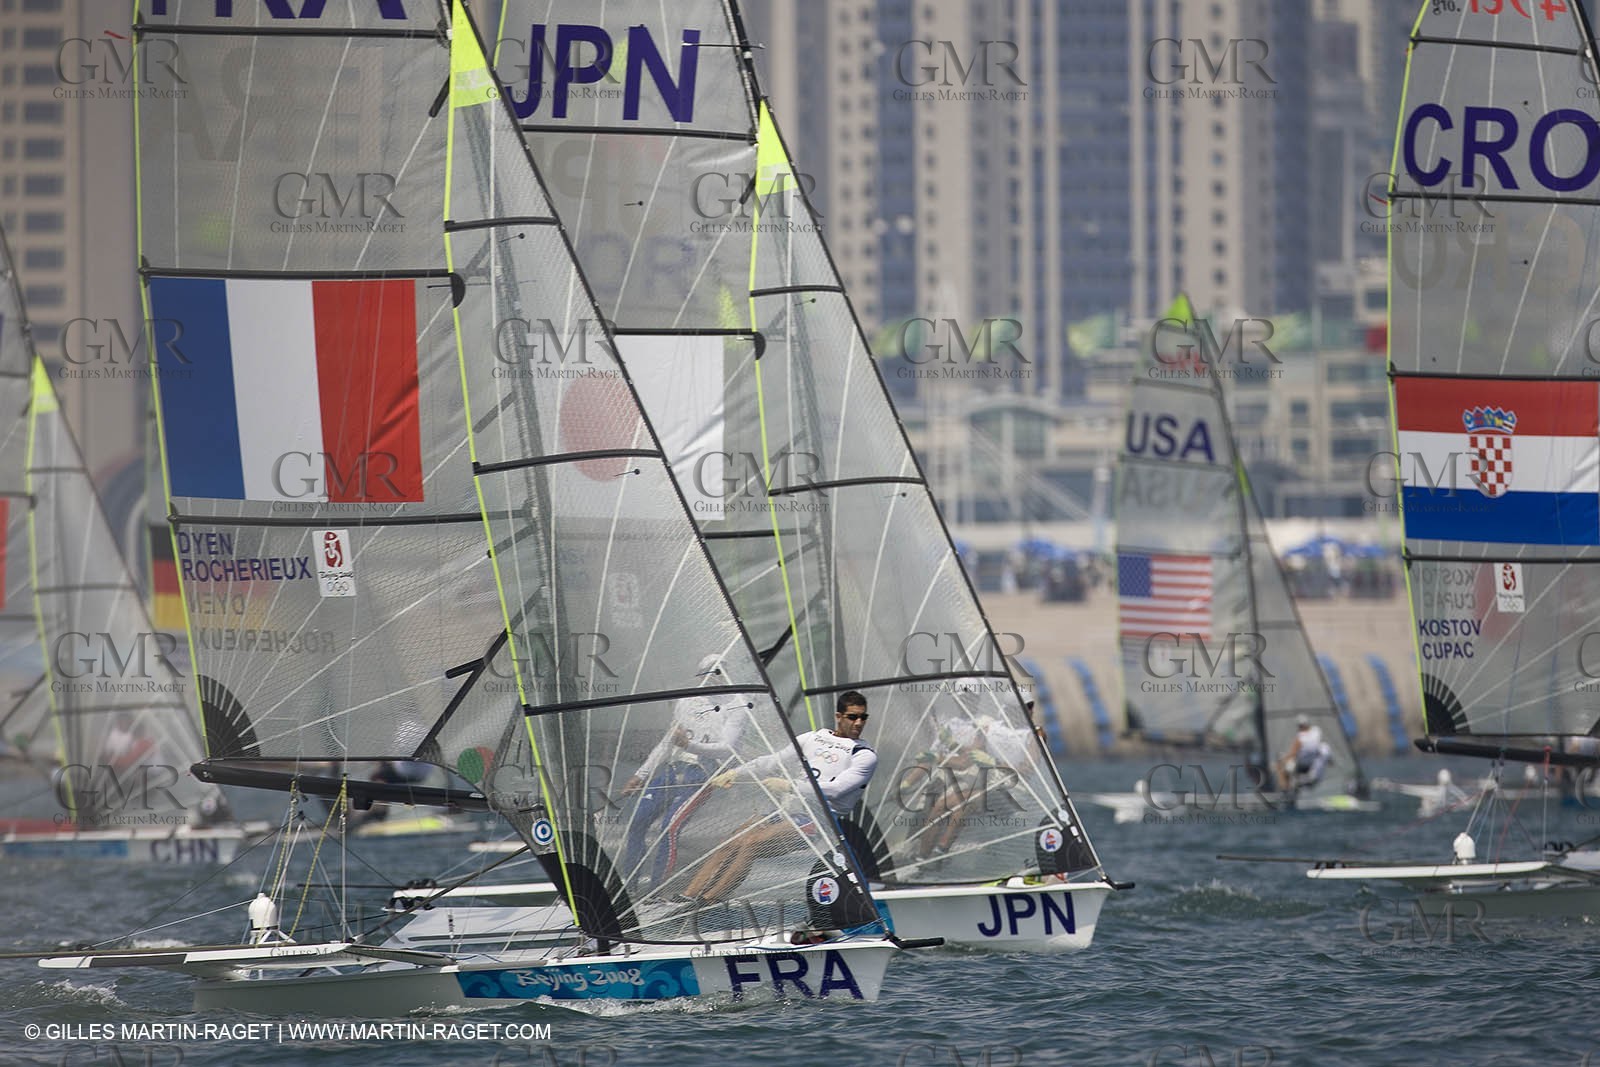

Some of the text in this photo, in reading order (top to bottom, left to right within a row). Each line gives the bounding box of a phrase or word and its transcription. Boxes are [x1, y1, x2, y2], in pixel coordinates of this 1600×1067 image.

[504, 23, 701, 123] JPN
[1403, 102, 1600, 192] CRO
[1125, 409, 1217, 464] USA
[178, 532, 234, 556] DYEN
[182, 556, 313, 583] ROCHERIEUX
[1418, 618, 1482, 637] KOSTOV
[1422, 641, 1475, 660] CUPAC
[149, 838, 220, 864] CHN
[977, 892, 1077, 937] JPN
[506, 967, 645, 992] Beijing 2008
[723, 949, 865, 1000] FRA
